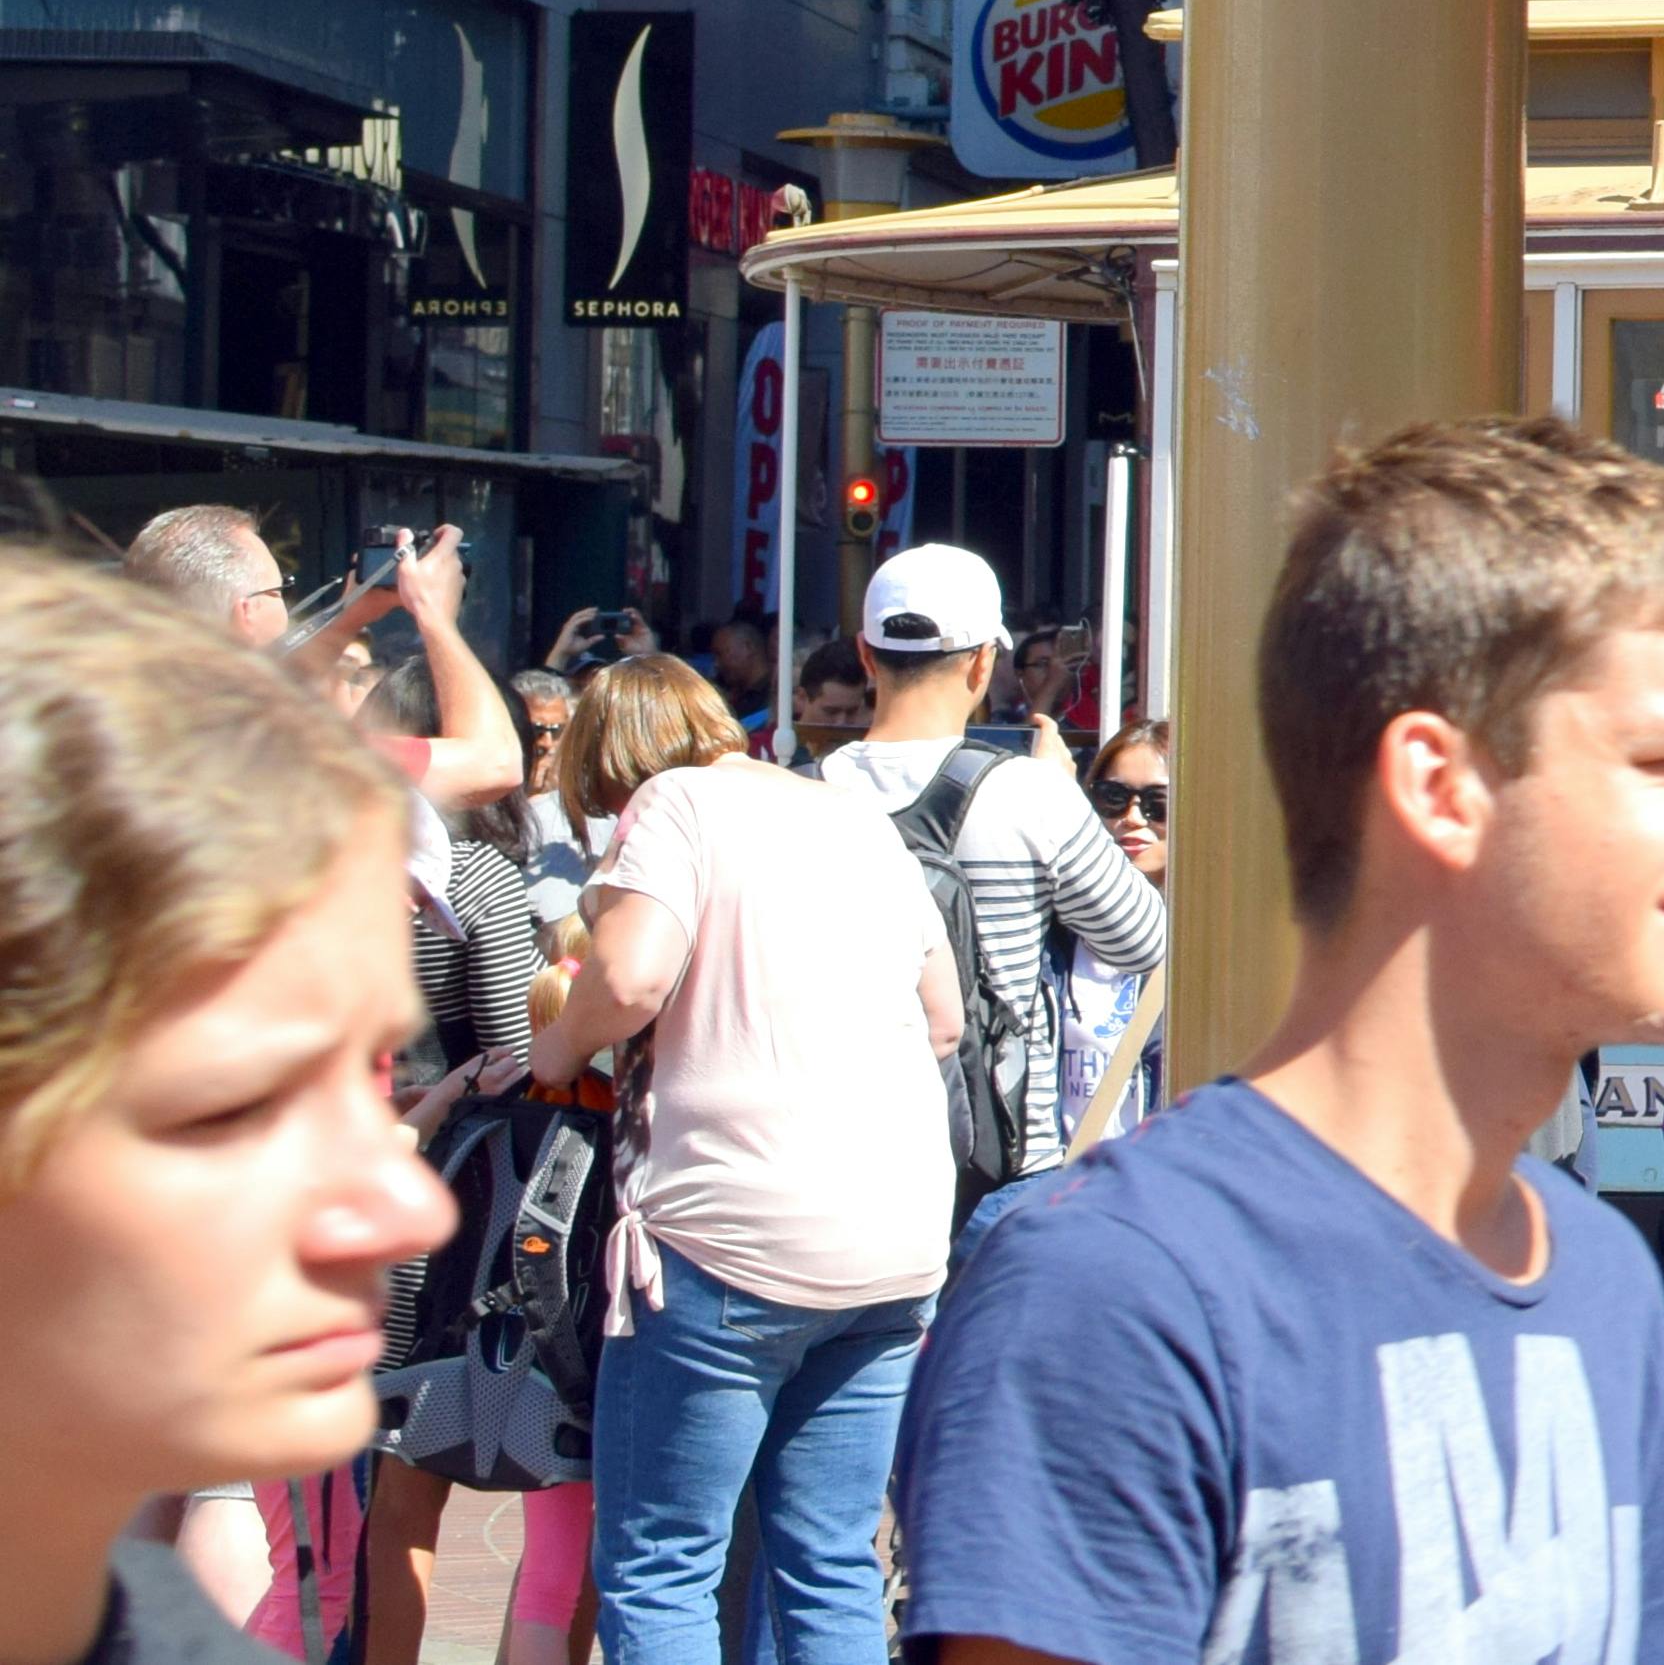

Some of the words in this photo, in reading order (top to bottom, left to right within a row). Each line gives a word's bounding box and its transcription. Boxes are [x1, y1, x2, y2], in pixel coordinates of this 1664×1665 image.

[999, 31, 1119, 118] KIN
[573, 300, 680, 318] SEPHORA
[743, 357, 784, 604] OPE
